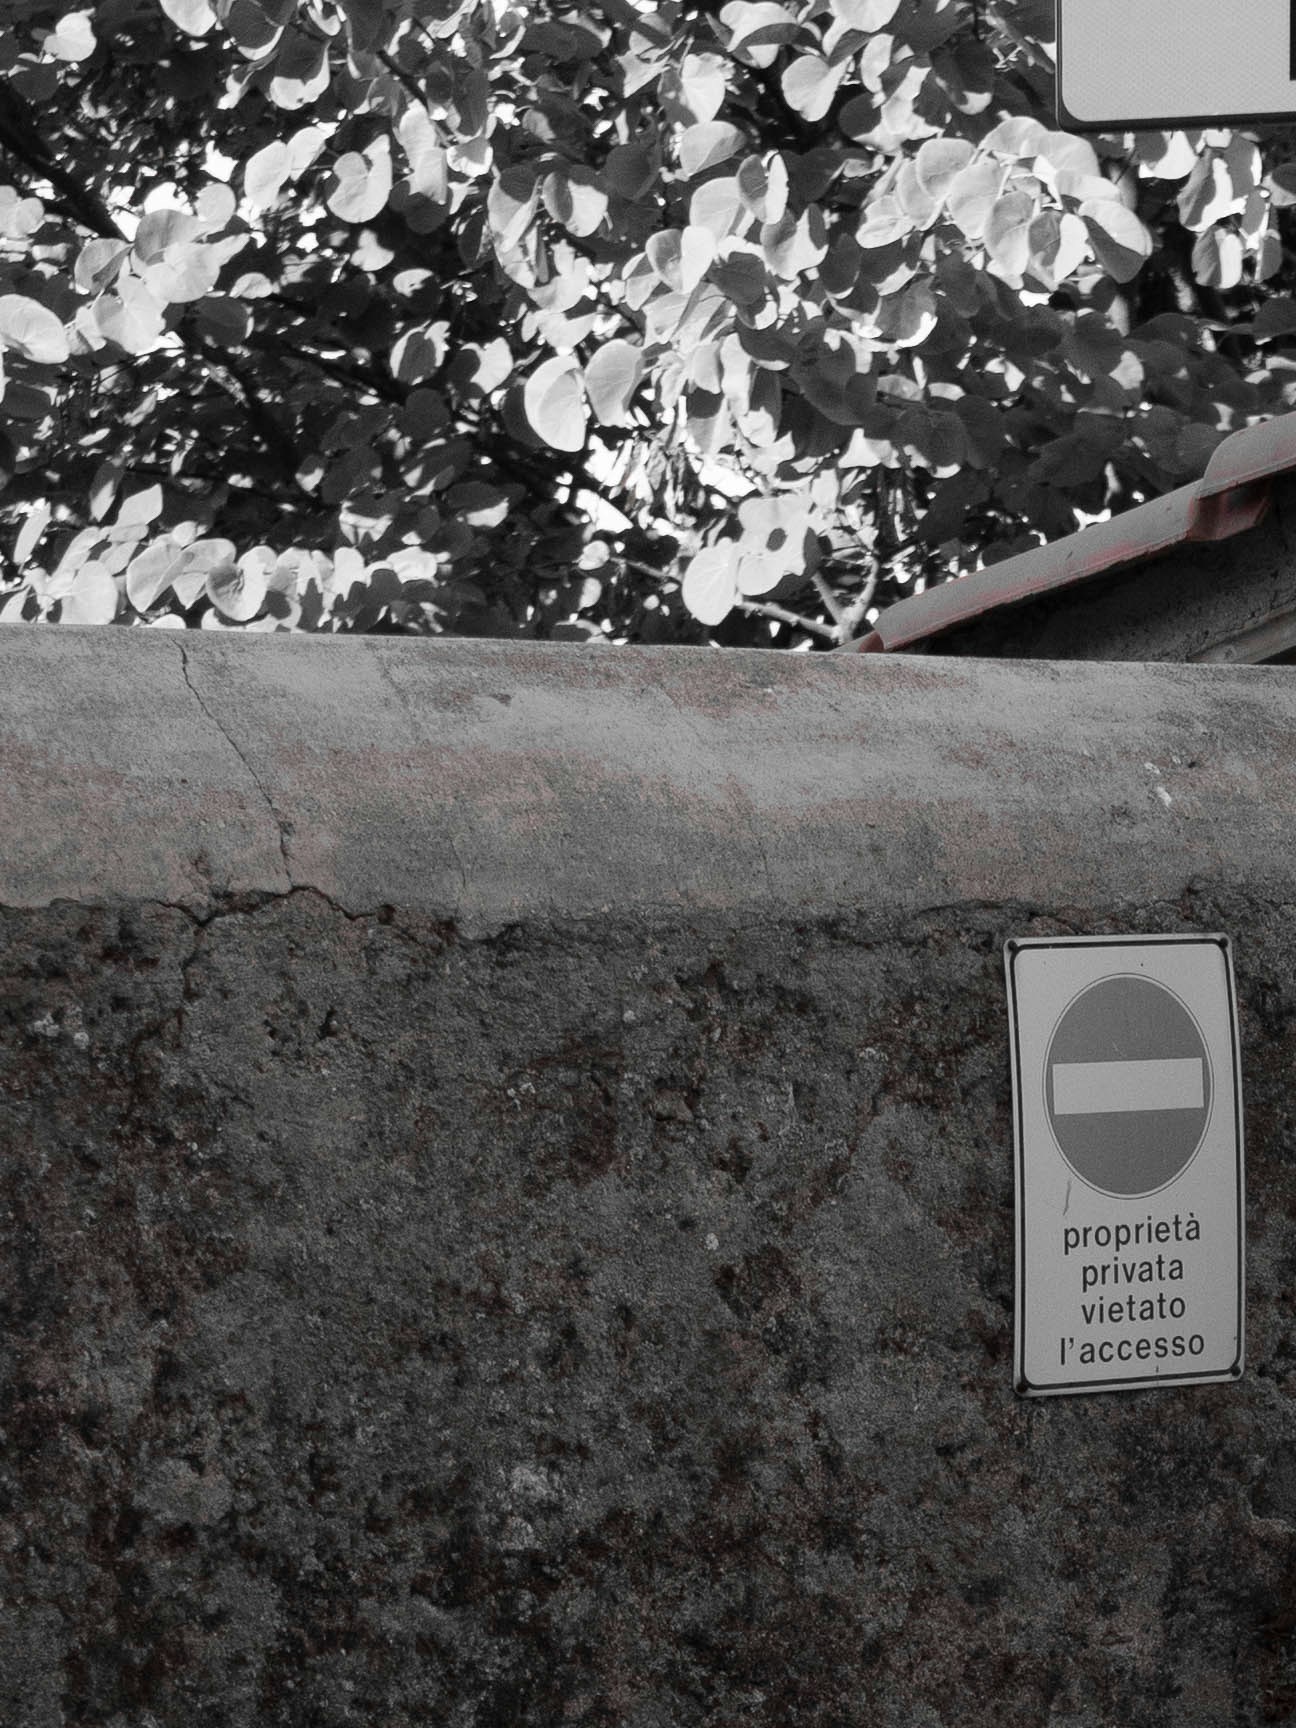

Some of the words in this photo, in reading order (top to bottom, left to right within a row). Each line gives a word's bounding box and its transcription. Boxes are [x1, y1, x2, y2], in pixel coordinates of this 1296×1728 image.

[1063, 1212, 1201, 1255] proprietà
[1082, 1255, 1184, 1292] privata
[1081, 1293, 1186, 1325] vietato
[1060, 1333, 1205, 1366] l'accesso
